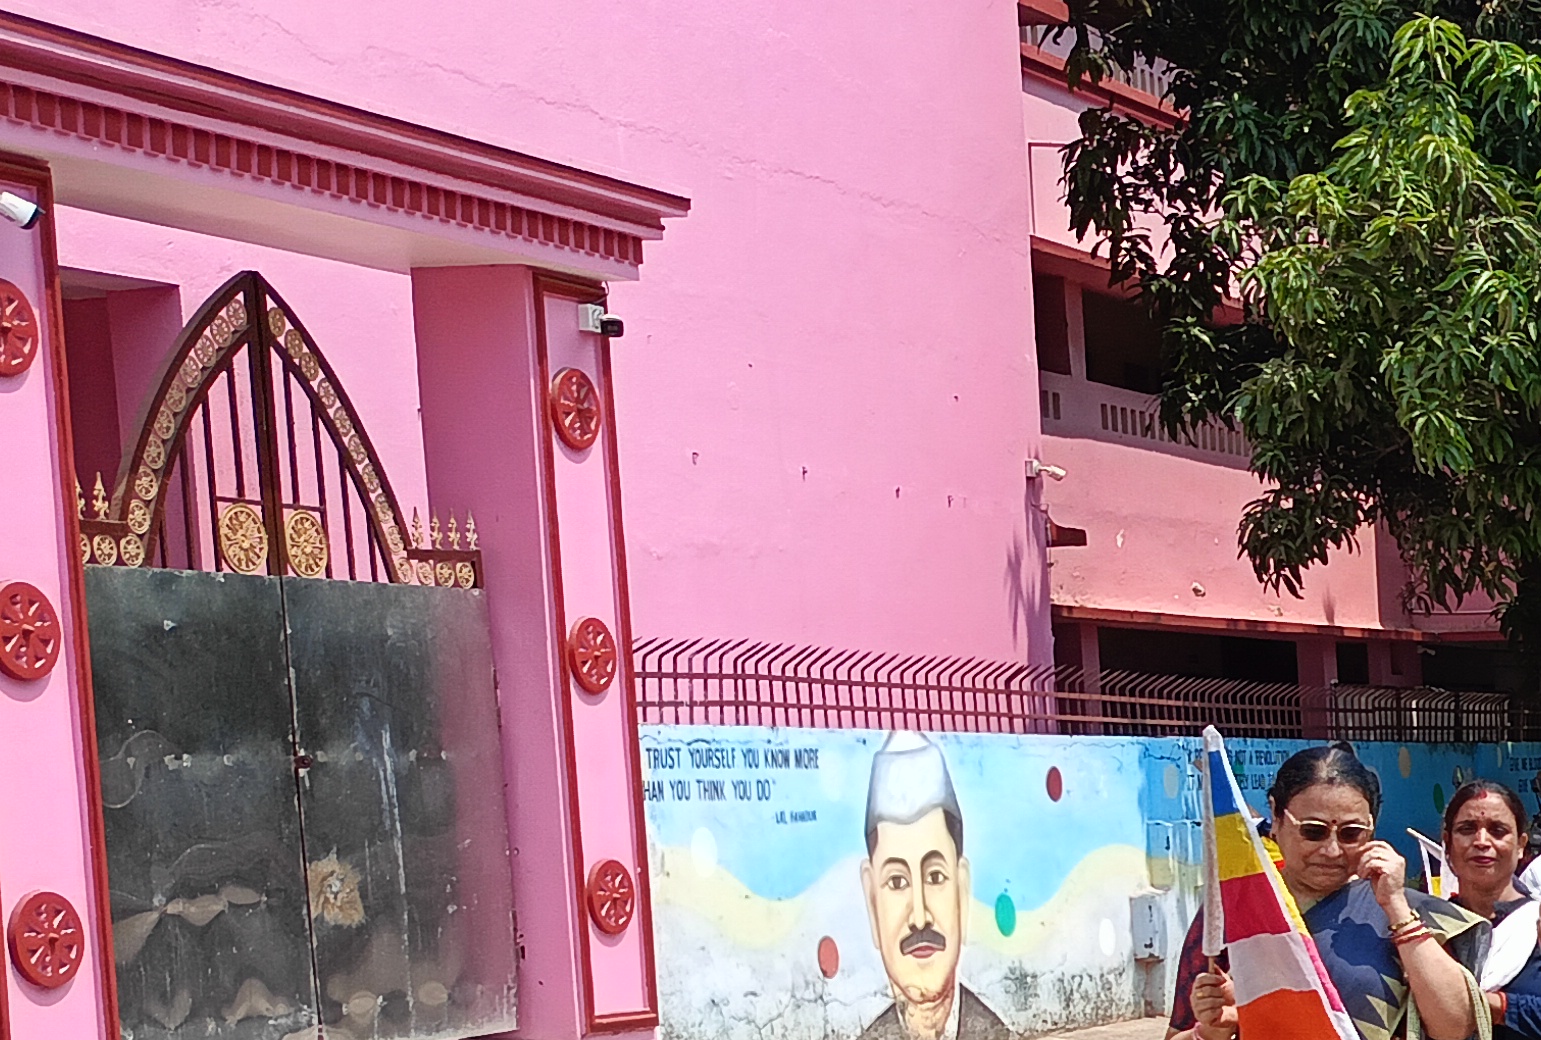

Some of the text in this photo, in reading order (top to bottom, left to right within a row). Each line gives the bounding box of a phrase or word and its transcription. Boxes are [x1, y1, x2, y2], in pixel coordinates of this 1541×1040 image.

[645, 747, 819, 770] TRUST YOURSELF YOU KNOW MORE
[642, 779, 664, 801] HAN
[669, 780, 691, 801] YOU
[696, 779, 726, 801] THINK
[731, 779, 751, 801] YOU
